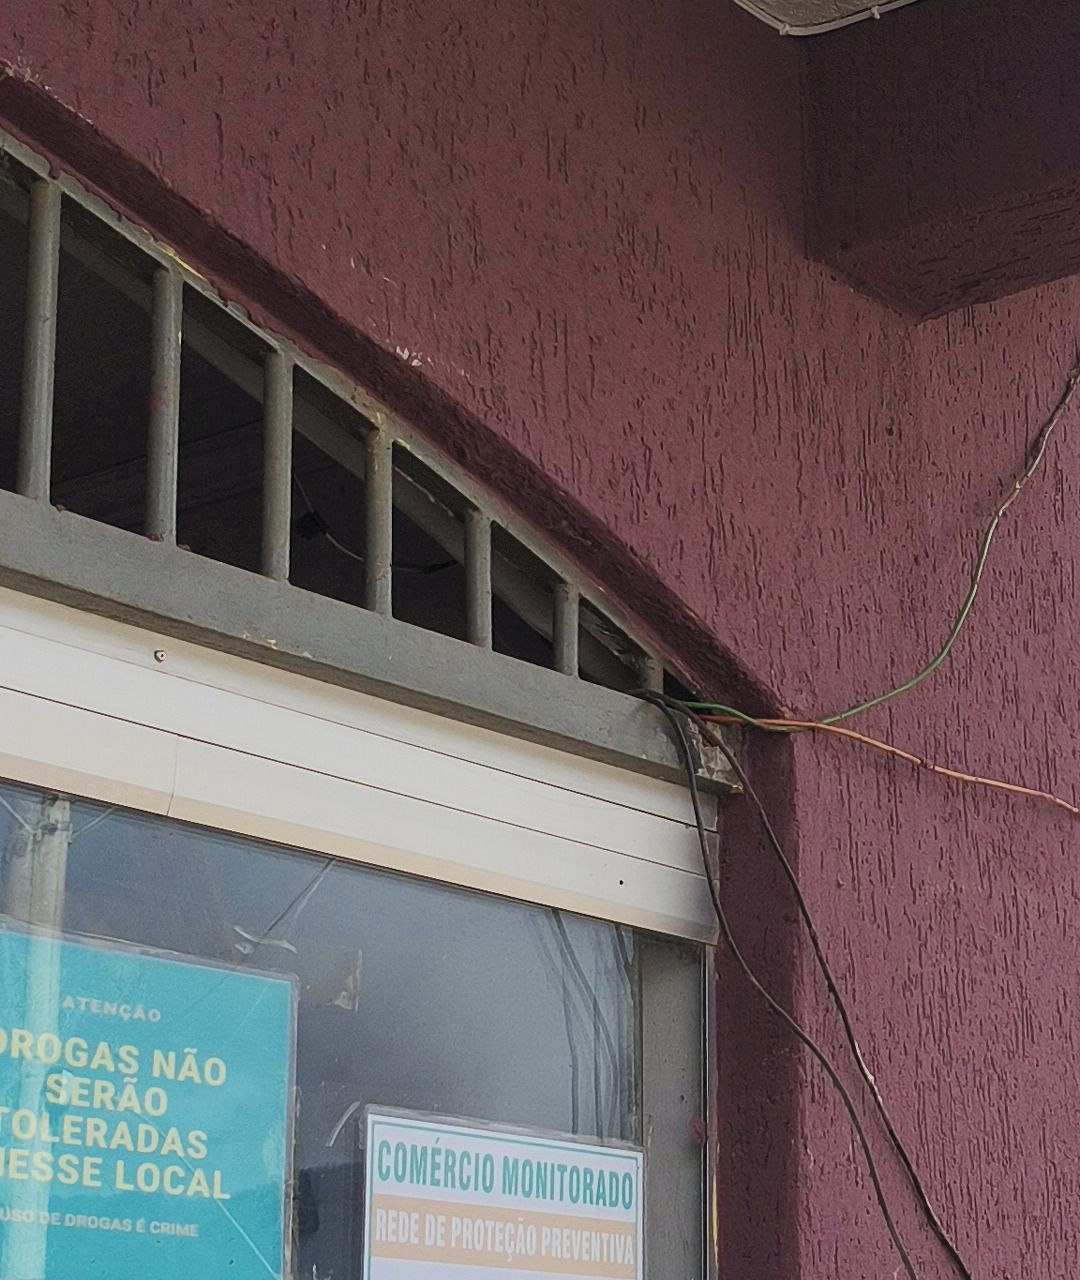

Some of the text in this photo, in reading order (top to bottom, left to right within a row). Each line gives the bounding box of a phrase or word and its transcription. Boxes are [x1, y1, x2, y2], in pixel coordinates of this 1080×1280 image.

[62, 994, 161, 1023] ATENÇÃO
[152, 1048, 227, 1087] NÃO
[45, 1073, 168, 1117] SERÃO
[0, 1147, 231, 1200] ESSE LOCAL
[377, 1138, 634, 1210] COMÉRCIO MONITORADO
[39, 1212, 61, 1226] DE
[65, 1214, 132, 1231] DROGAS
[136, 1218, 146, 1232] É
[150, 1220, 199, 1237] CRIME
[376, 1208, 634, 1265] REDE DE PROTEÇÃO PREVENTIVA
